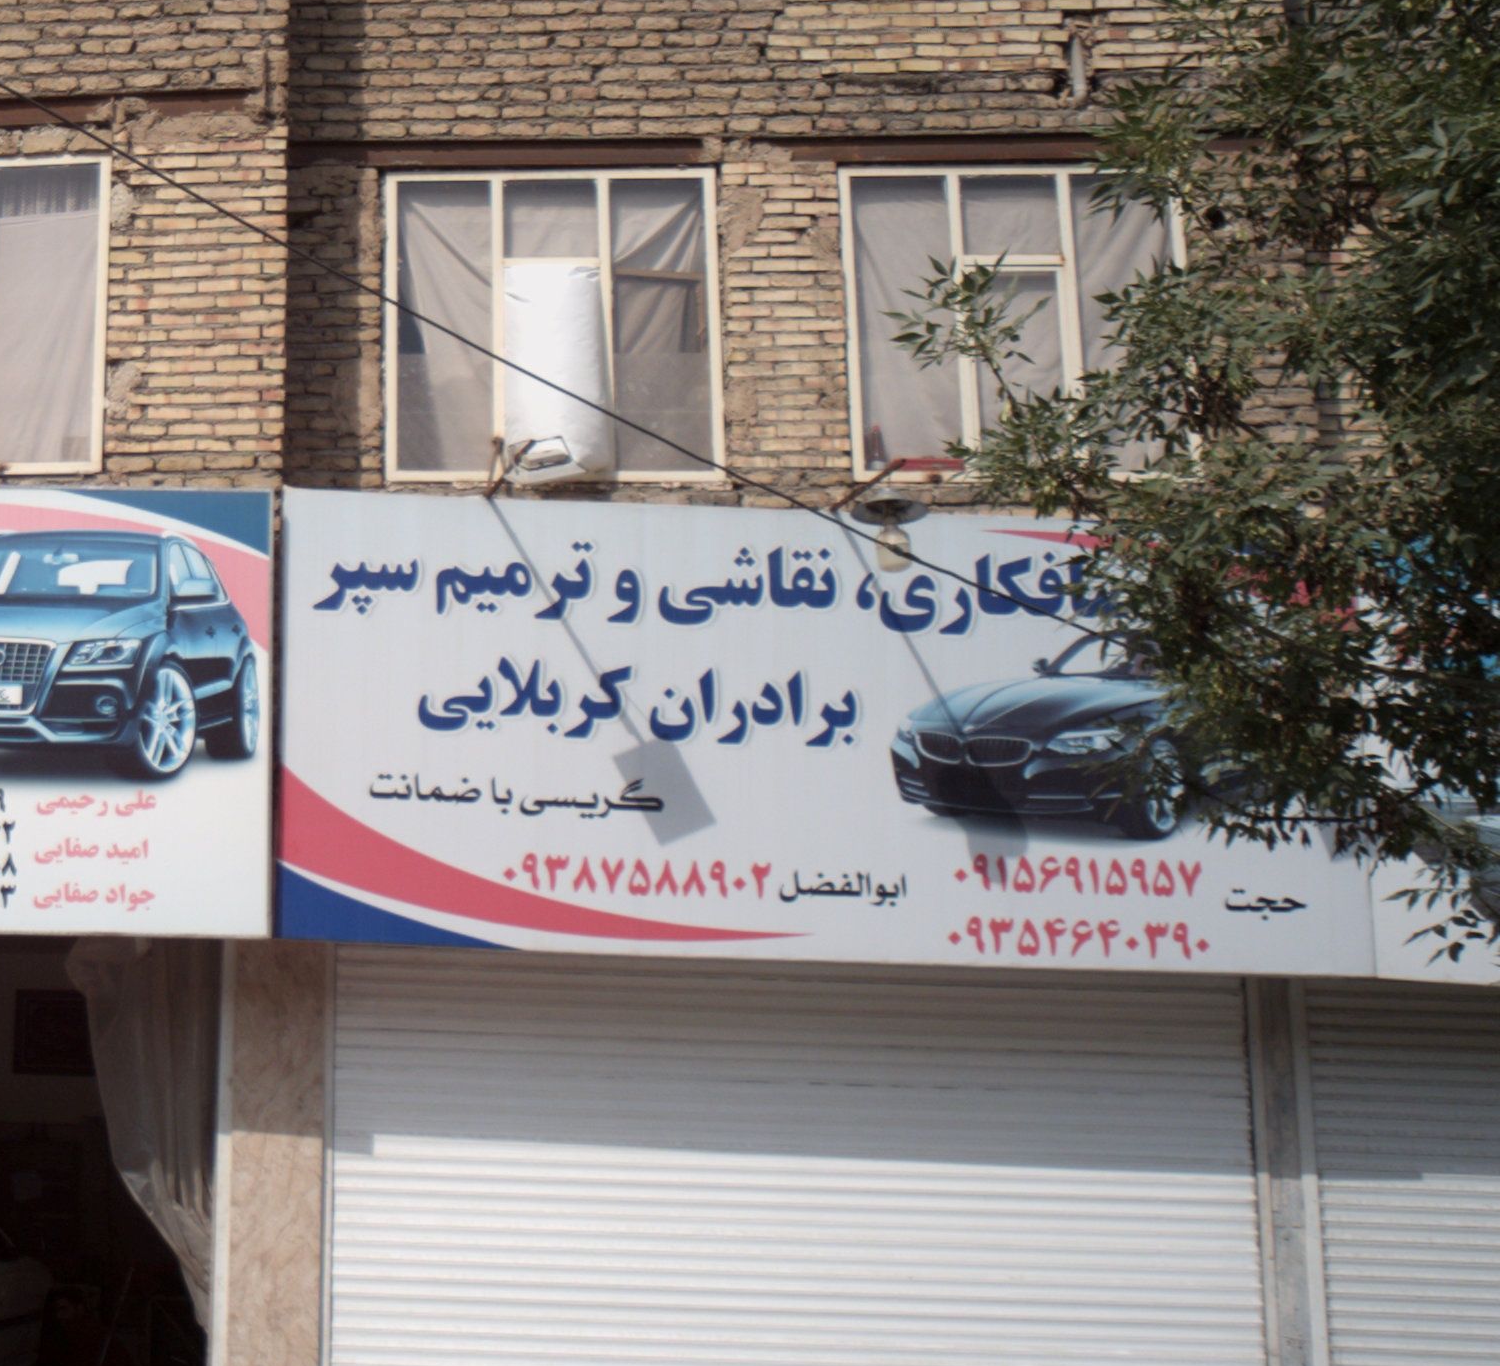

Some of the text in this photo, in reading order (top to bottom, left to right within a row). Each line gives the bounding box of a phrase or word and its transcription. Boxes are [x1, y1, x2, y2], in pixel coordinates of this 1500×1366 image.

[313, 542, 1130, 635] افکاری، نقاشی و ترمیم سپر
[417, 656, 857, 747] برادران کربلایی
[115, 790, 157, 817] علی
[369, 773, 482, 803] ضمانت
[491, 777, 513, 814] با
[106, 838, 149, 865] امید
[502, 851, 908, 908] ابوالفضل ۰۹۳۸۷۵۸۸۹۰۲
[954, 853, 1202, 897] ۰۹۱۵۶۹۱۵۹۵۷
[105, 884, 156, 911] جواد
[1224, 886, 1307, 920] حجت
[948, 916, 1210, 960] ۰۹۳۵۴۶۴۰۳۹۰
